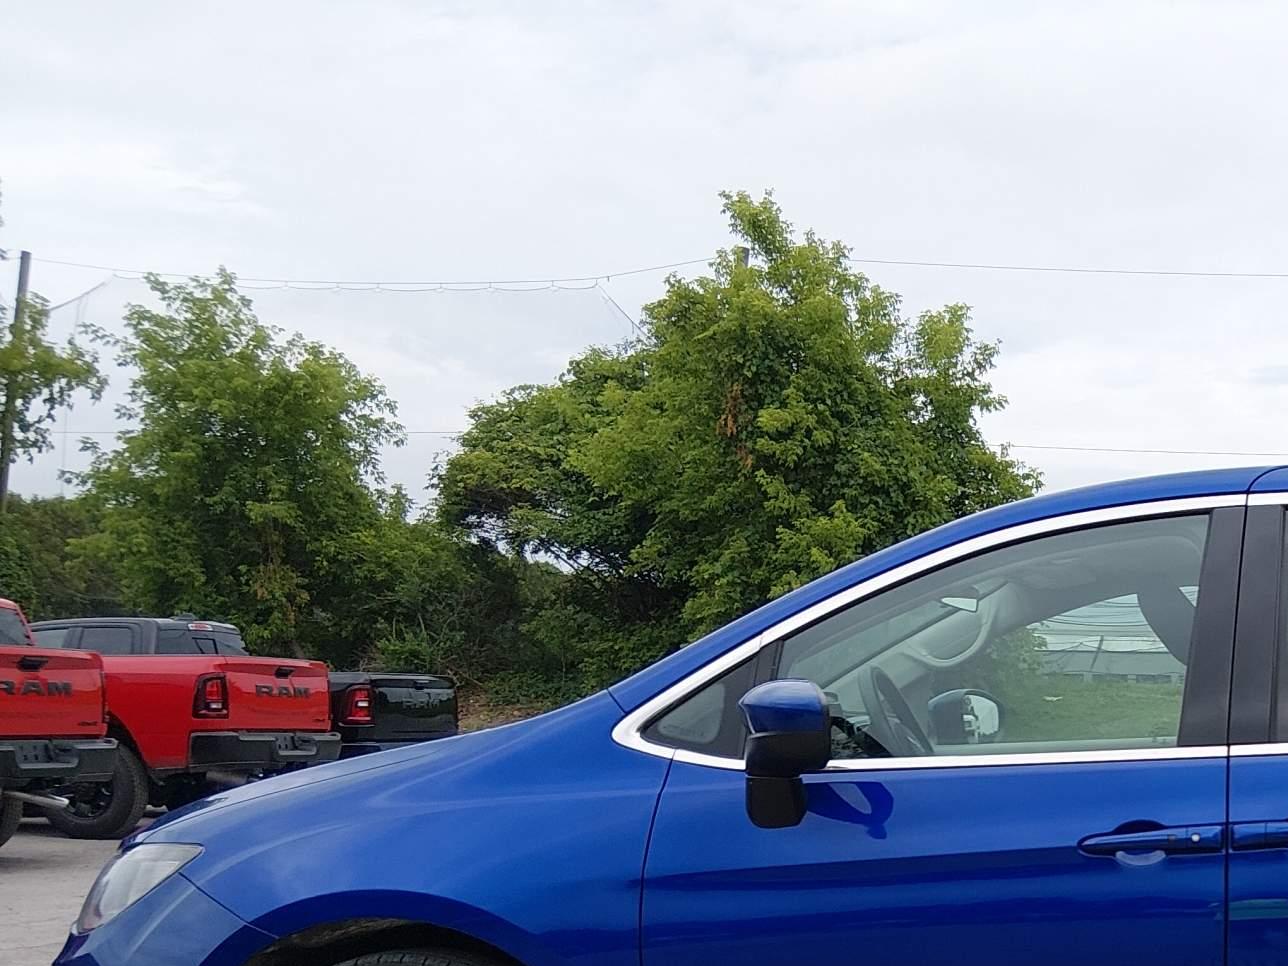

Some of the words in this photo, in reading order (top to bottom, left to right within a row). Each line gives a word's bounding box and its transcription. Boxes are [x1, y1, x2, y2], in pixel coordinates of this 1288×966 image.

[0, 680, 73, 697] RAM
[255, 684, 311, 698] RAM
[401, 698, 440, 709] RAM
